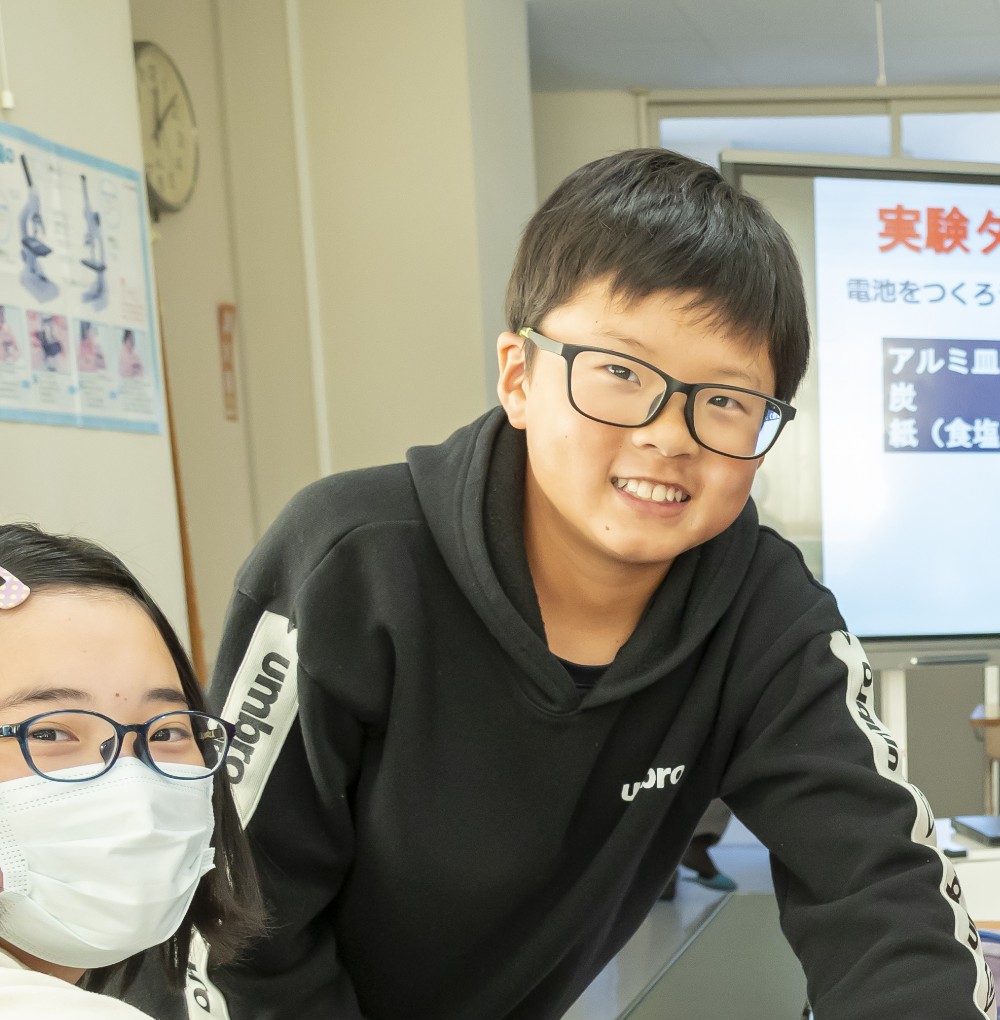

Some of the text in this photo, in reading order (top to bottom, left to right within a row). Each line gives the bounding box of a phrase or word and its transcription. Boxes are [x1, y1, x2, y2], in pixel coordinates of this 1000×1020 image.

[888, 347, 1000, 376] アルミ皿
[890, 383, 917, 413] 炭
[224, 651, 290, 785] umbro
